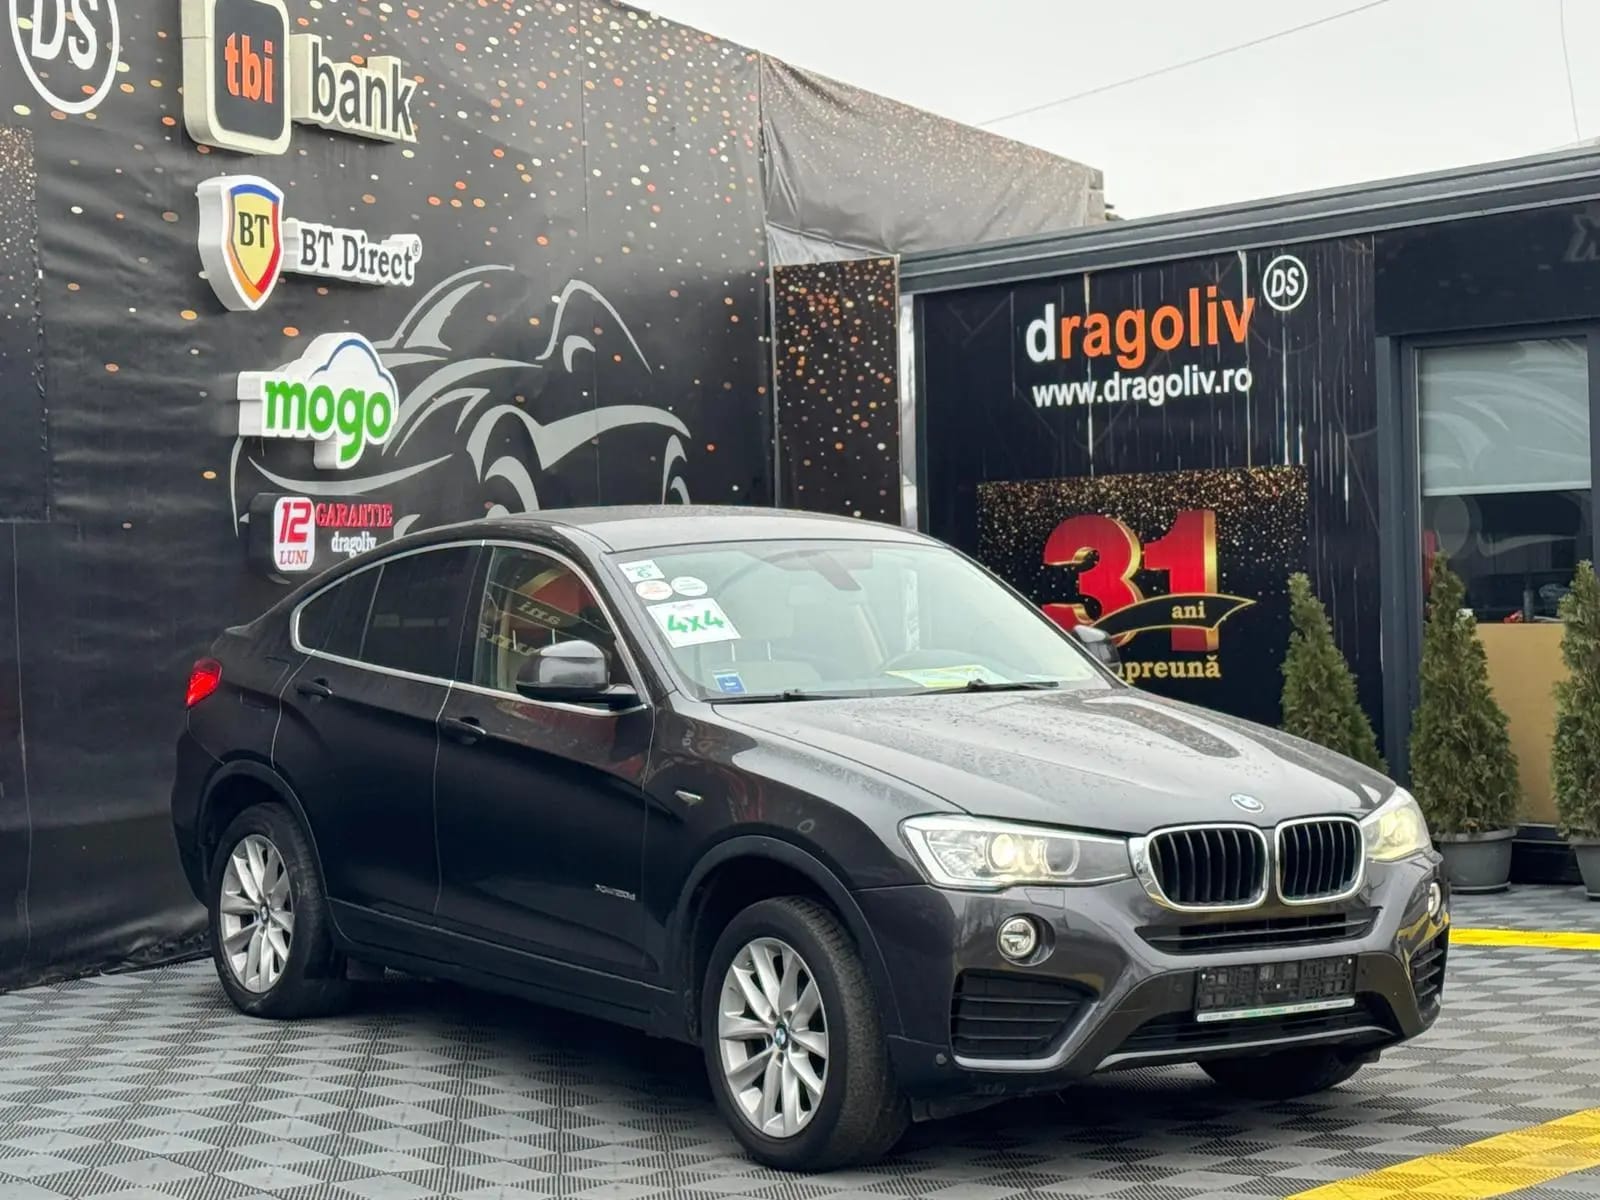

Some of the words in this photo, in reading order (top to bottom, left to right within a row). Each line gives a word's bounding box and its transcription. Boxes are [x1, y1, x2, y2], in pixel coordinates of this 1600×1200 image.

[224, 31, 275, 103] tbi
[312, 41, 415, 138] bank
[239, 211, 270, 249] BT
[301, 229, 333, 268] BT
[1272, 267, 1299, 297] DS
[1026, 285, 1255, 369] dragoliv
[1032, 365, 1252, 407] www.dragoliv.ro
[265, 380, 392, 462] mogo
[279, 502, 311, 543] 12
[315, 503, 393, 527] GARANTIE
[279, 550, 308, 565] LUNI
[1041, 510, 1219, 652] 31
[1172, 600, 1206, 619] ani
[1117, 655, 1221, 684] preună
